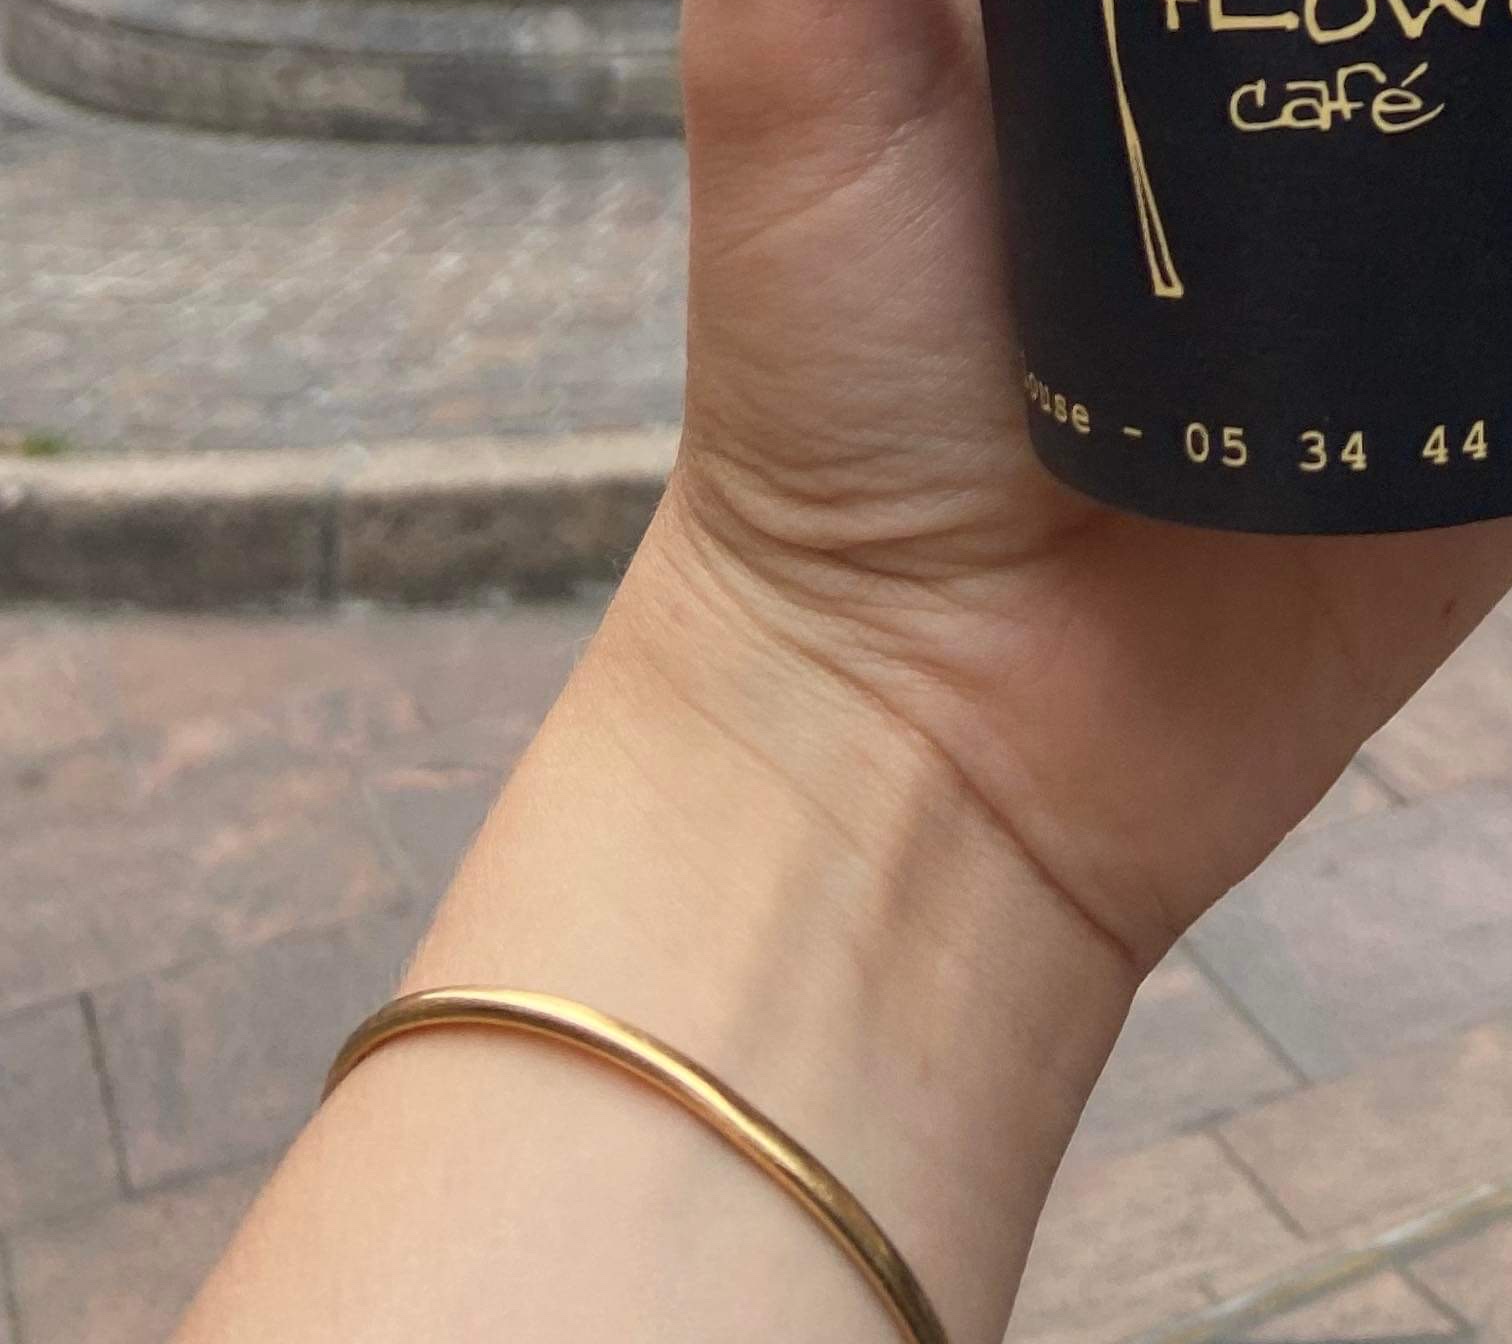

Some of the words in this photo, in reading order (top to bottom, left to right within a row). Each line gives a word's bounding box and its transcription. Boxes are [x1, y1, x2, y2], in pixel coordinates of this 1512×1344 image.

[1229, 61, 1446, 134] café
[1024, 372, 1091, 433] ouse
[1185, 422, 1249, 468] 05
[1299, 430, 1368, 472] 34
[1422, 420, 1489, 466] 44
